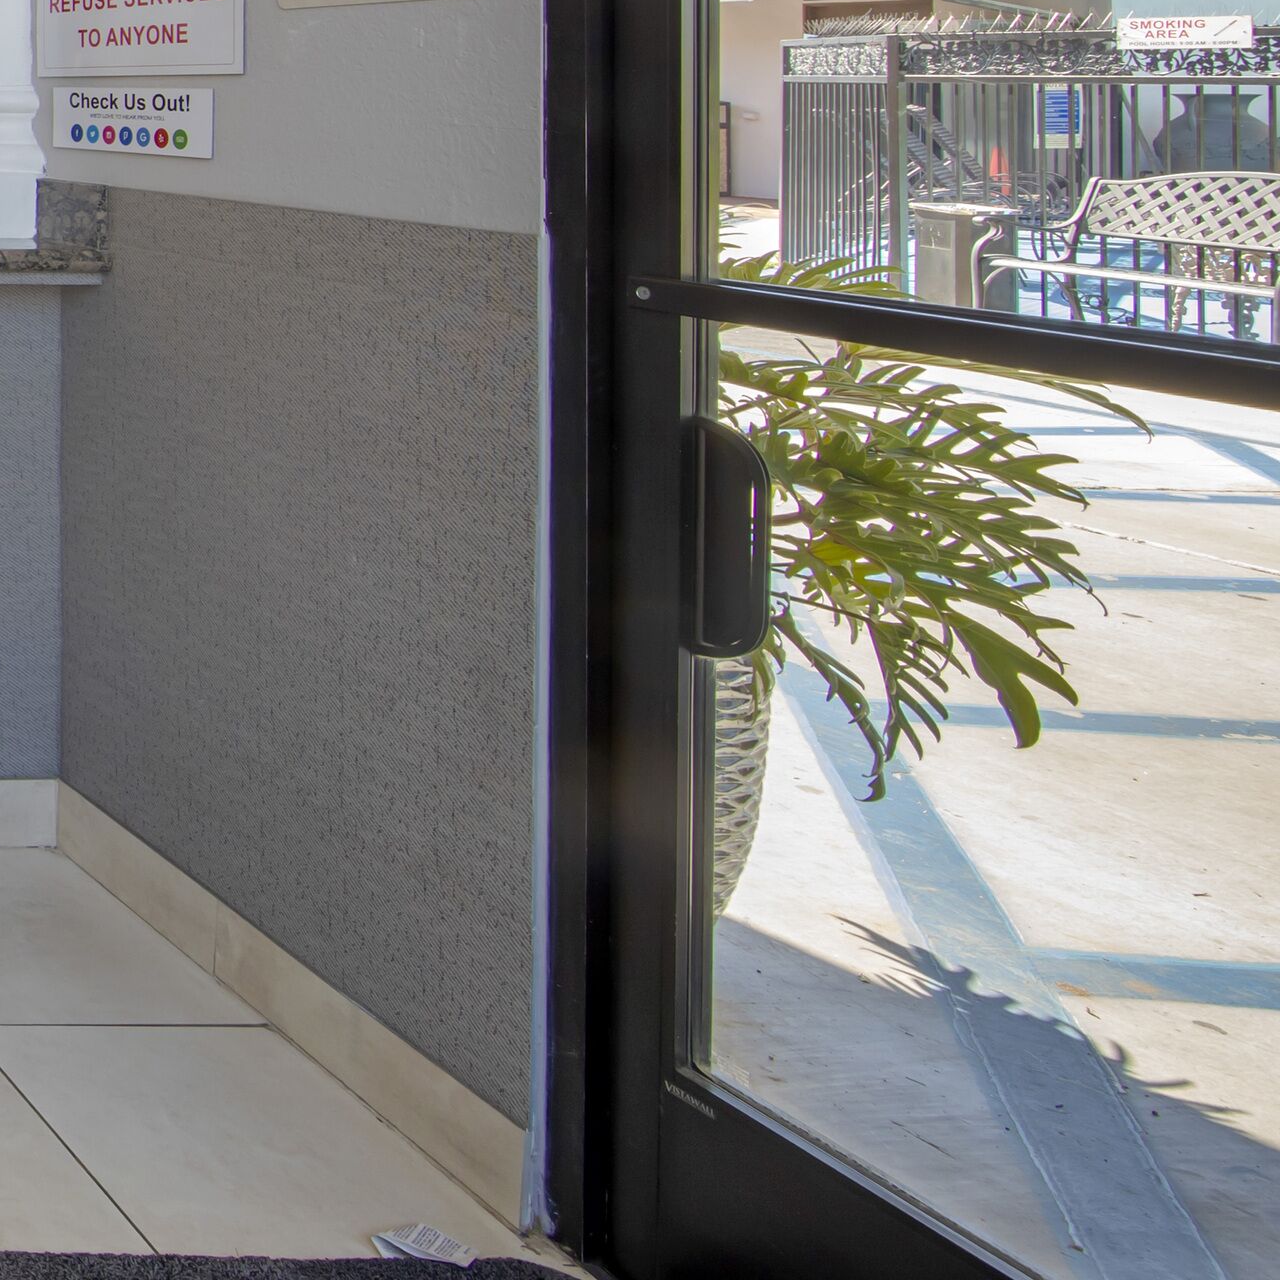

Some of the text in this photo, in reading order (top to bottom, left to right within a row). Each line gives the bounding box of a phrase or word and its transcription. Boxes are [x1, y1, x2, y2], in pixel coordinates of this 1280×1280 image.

[1130, 20, 1206, 29] SMOKING
[78, 23, 188, 48] TO ANYONE
[1145, 30, 1189, 38] AREA
[70, 92, 190, 112] Check Us Out!
